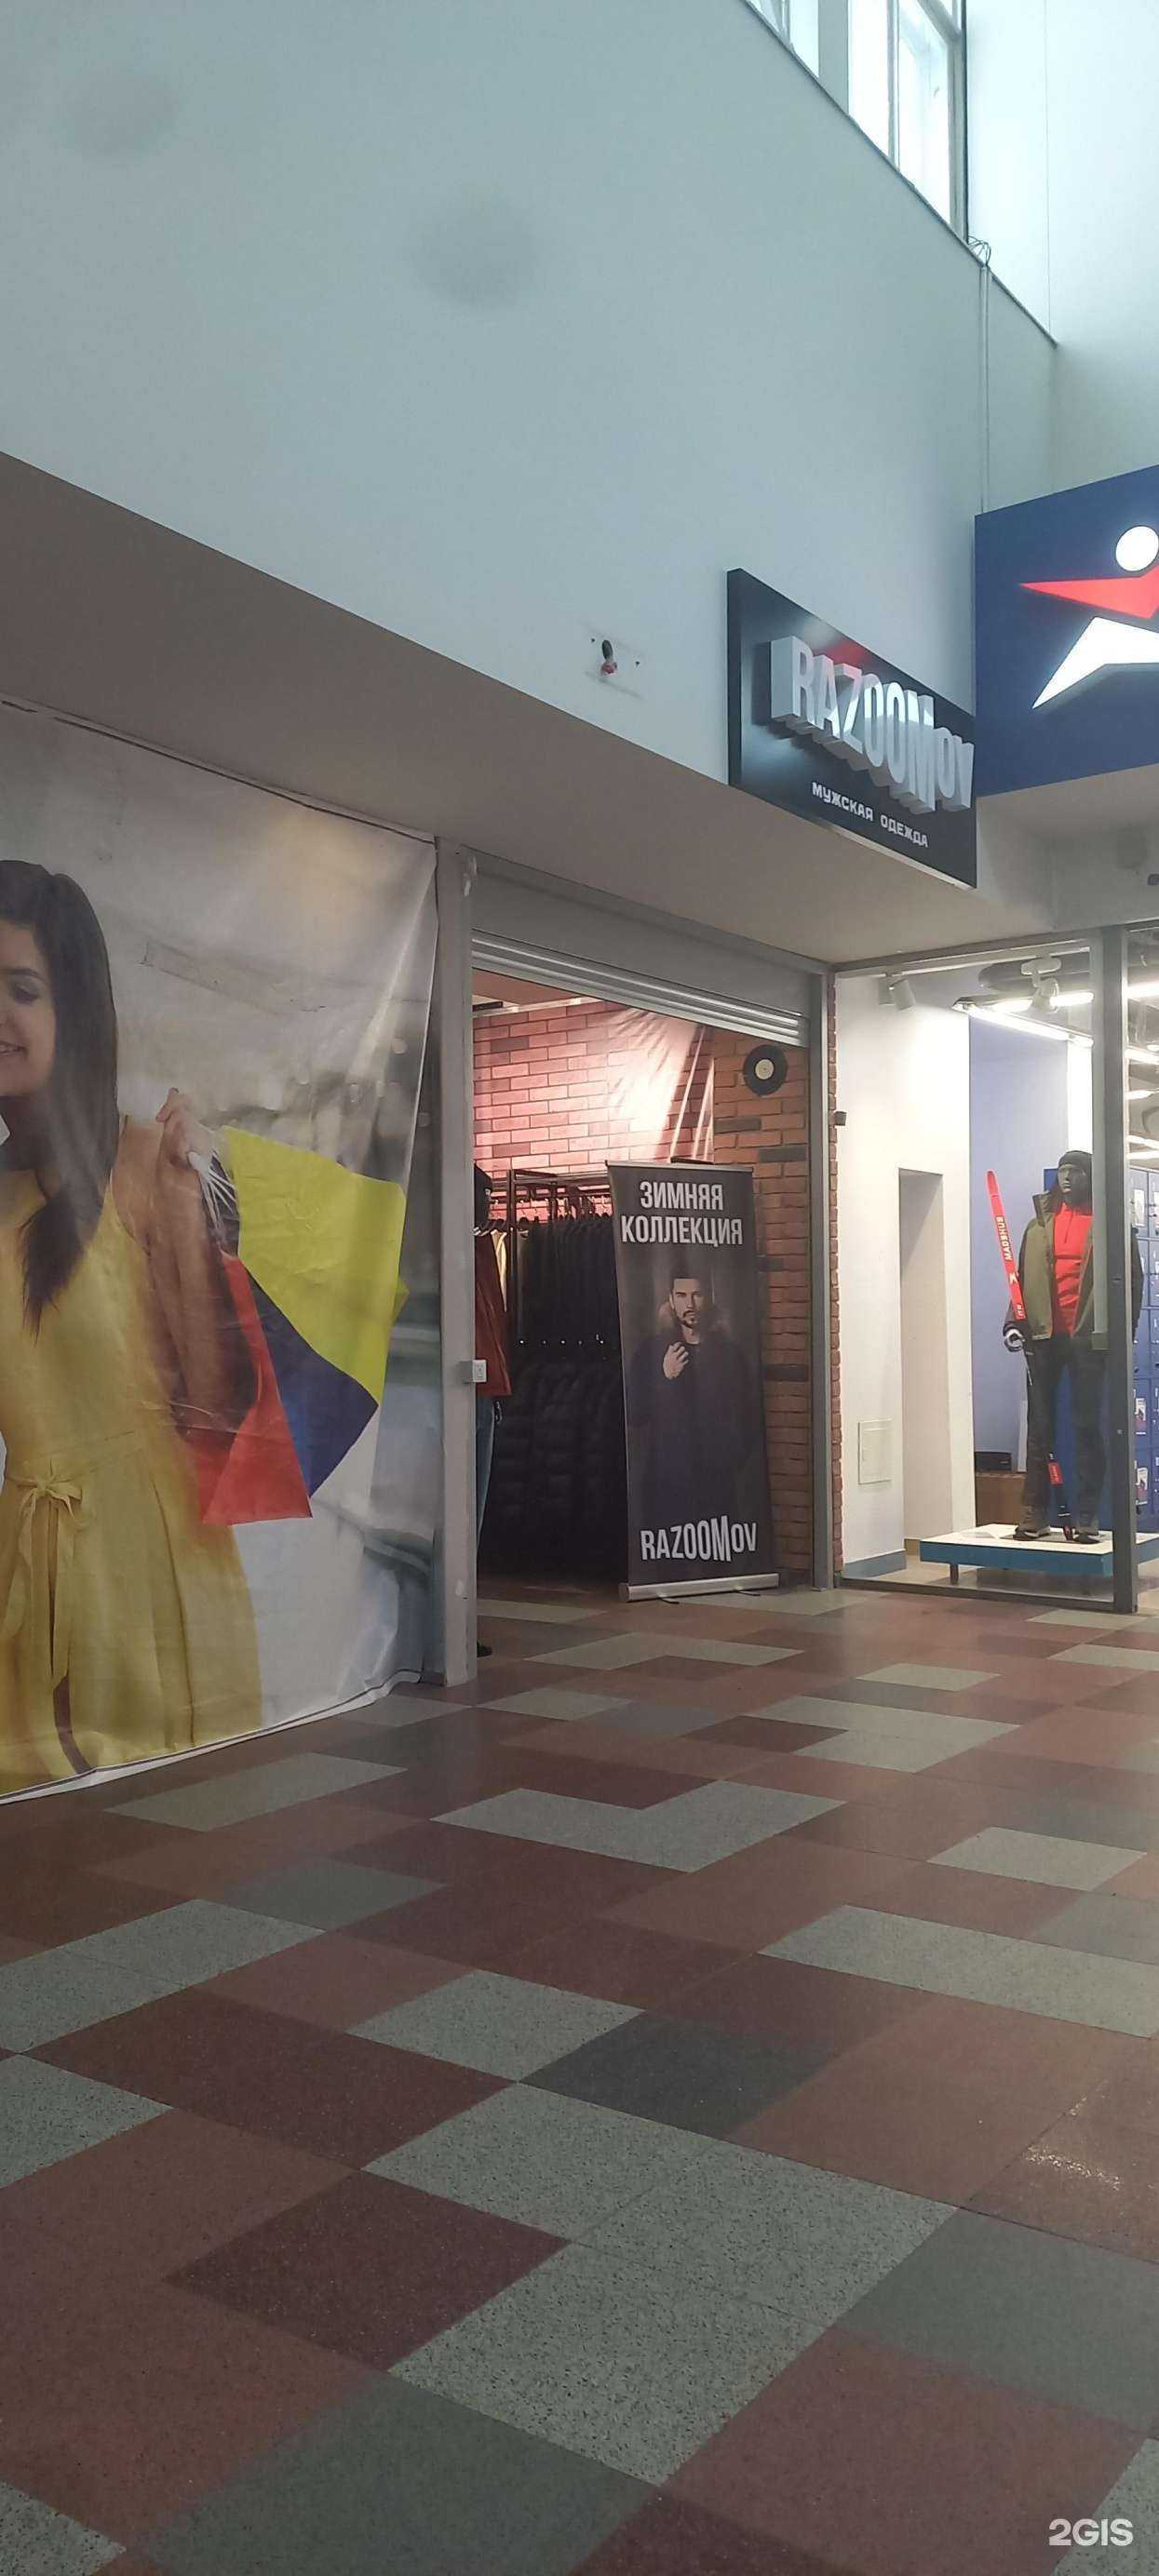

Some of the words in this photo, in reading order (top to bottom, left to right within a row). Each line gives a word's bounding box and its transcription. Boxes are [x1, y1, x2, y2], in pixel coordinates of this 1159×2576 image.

[812, 782, 873, 821] МУЖСКАЯ
[880, 814, 928, 848] ОДЕЖДА
[640, 1181, 723, 1210] ЗИМНЯЯ
[621, 1214, 743, 1247] КОЛЛЕКЦИЯ
